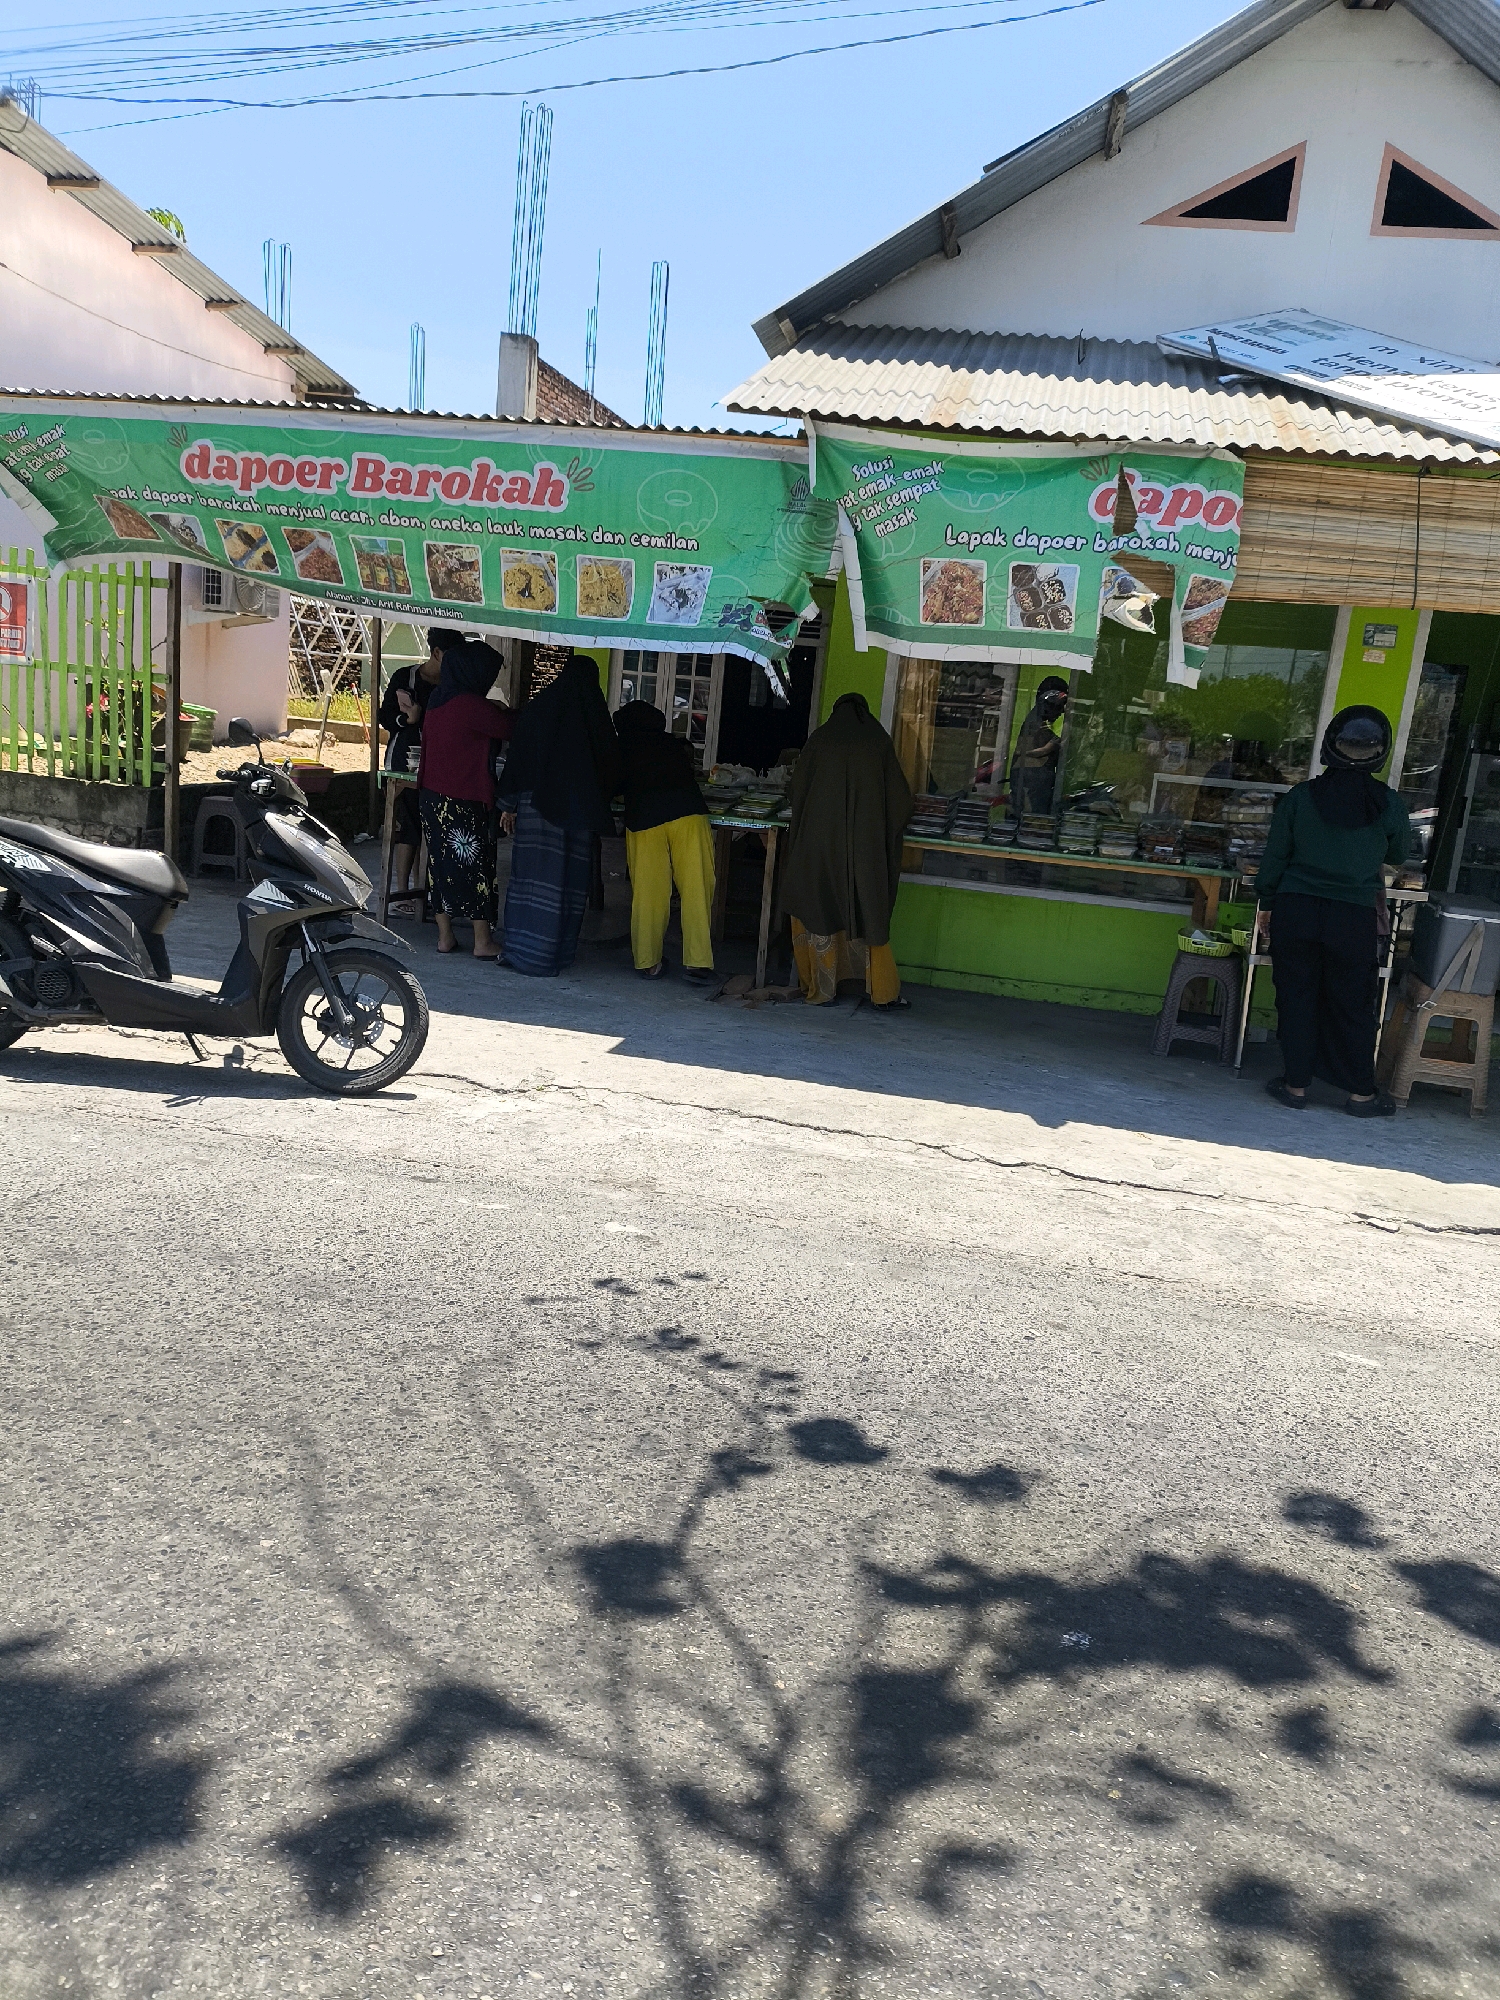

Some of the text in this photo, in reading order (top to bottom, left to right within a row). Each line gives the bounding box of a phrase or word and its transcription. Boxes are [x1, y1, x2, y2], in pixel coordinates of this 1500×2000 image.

[184, 445, 565, 508] dapoer Barokah
[852, 455, 895, 482] Solusi
[858, 460, 945, 501] emak-emak
[142, 483, 195, 507] dapoer
[265, 502, 327, 522] menjual
[330, 510, 375, 526] acar,
[379, 508, 426, 530] abon,
[430, 515, 483, 534] aneka
[487, 518, 525, 537] lauk
[528, 524, 588, 542] masak
[591, 525, 626, 545] dan
[630, 532, 699, 551] cemilan
[861, 500, 885, 521] tak
[885, 478, 941, 511] sempat
[1094, 472, 1242, 526] dapo
[873, 506, 918, 537] masak
[945, 523, 1007, 553] Lapak
[1012, 525, 1088, 555] dapoer
[1093, 531, 1180, 553] barokah
[396, 601, 432, 616] Rahman
[433, 606, 464, 619] Hakim
